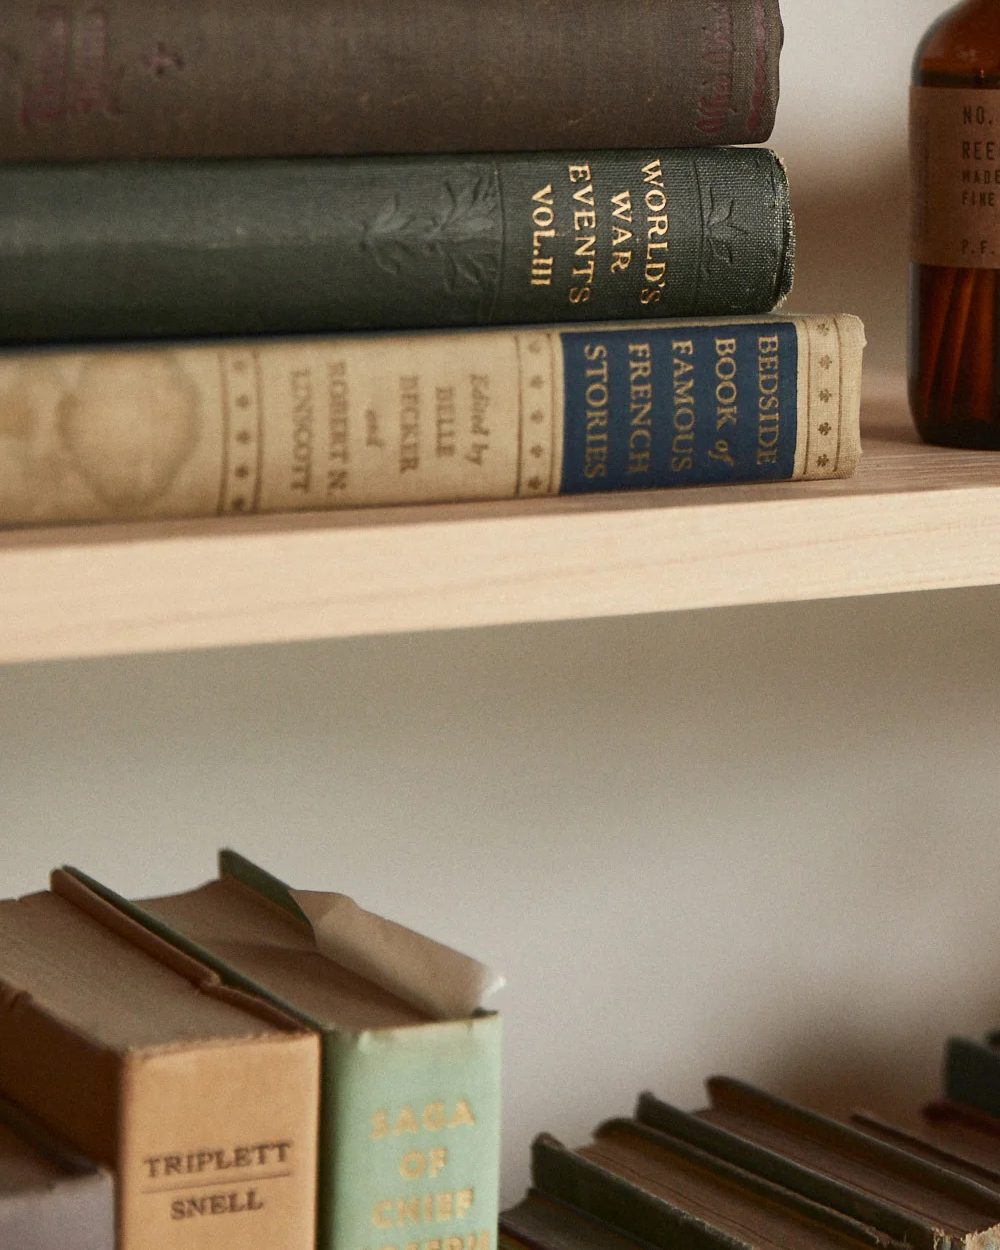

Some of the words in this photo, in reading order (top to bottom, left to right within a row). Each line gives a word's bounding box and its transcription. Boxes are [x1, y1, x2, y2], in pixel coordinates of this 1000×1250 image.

[962, 105, 994, 126] NO.
[962, 169, 1000, 184] MADE
[961, 191, 996, 207] FINE
[568, 163, 597, 304] EVENTS
[610, 190, 633, 274] WAR
[640, 158, 669, 305] WORLD'S
[469, 373, 491, 437] Edited
[670, 338, 696, 472] FAMOUS
[714, 336, 738, 431] BOOK
[756, 333, 780, 466] BEDSIDE
[583, 343, 609, 479] STORIES
[627, 342, 653, 475] FRENCH
[464, 443, 489, 467] by
[707, 439, 736, 467] of
[370, 1097, 477, 1141] SAGA
[142, 1138, 294, 1179] TRIPLETT
[399, 1146, 448, 1180] OF
[169, 1186, 265, 1221] SNELL
[371, 1185, 474, 1229] CHIEF
